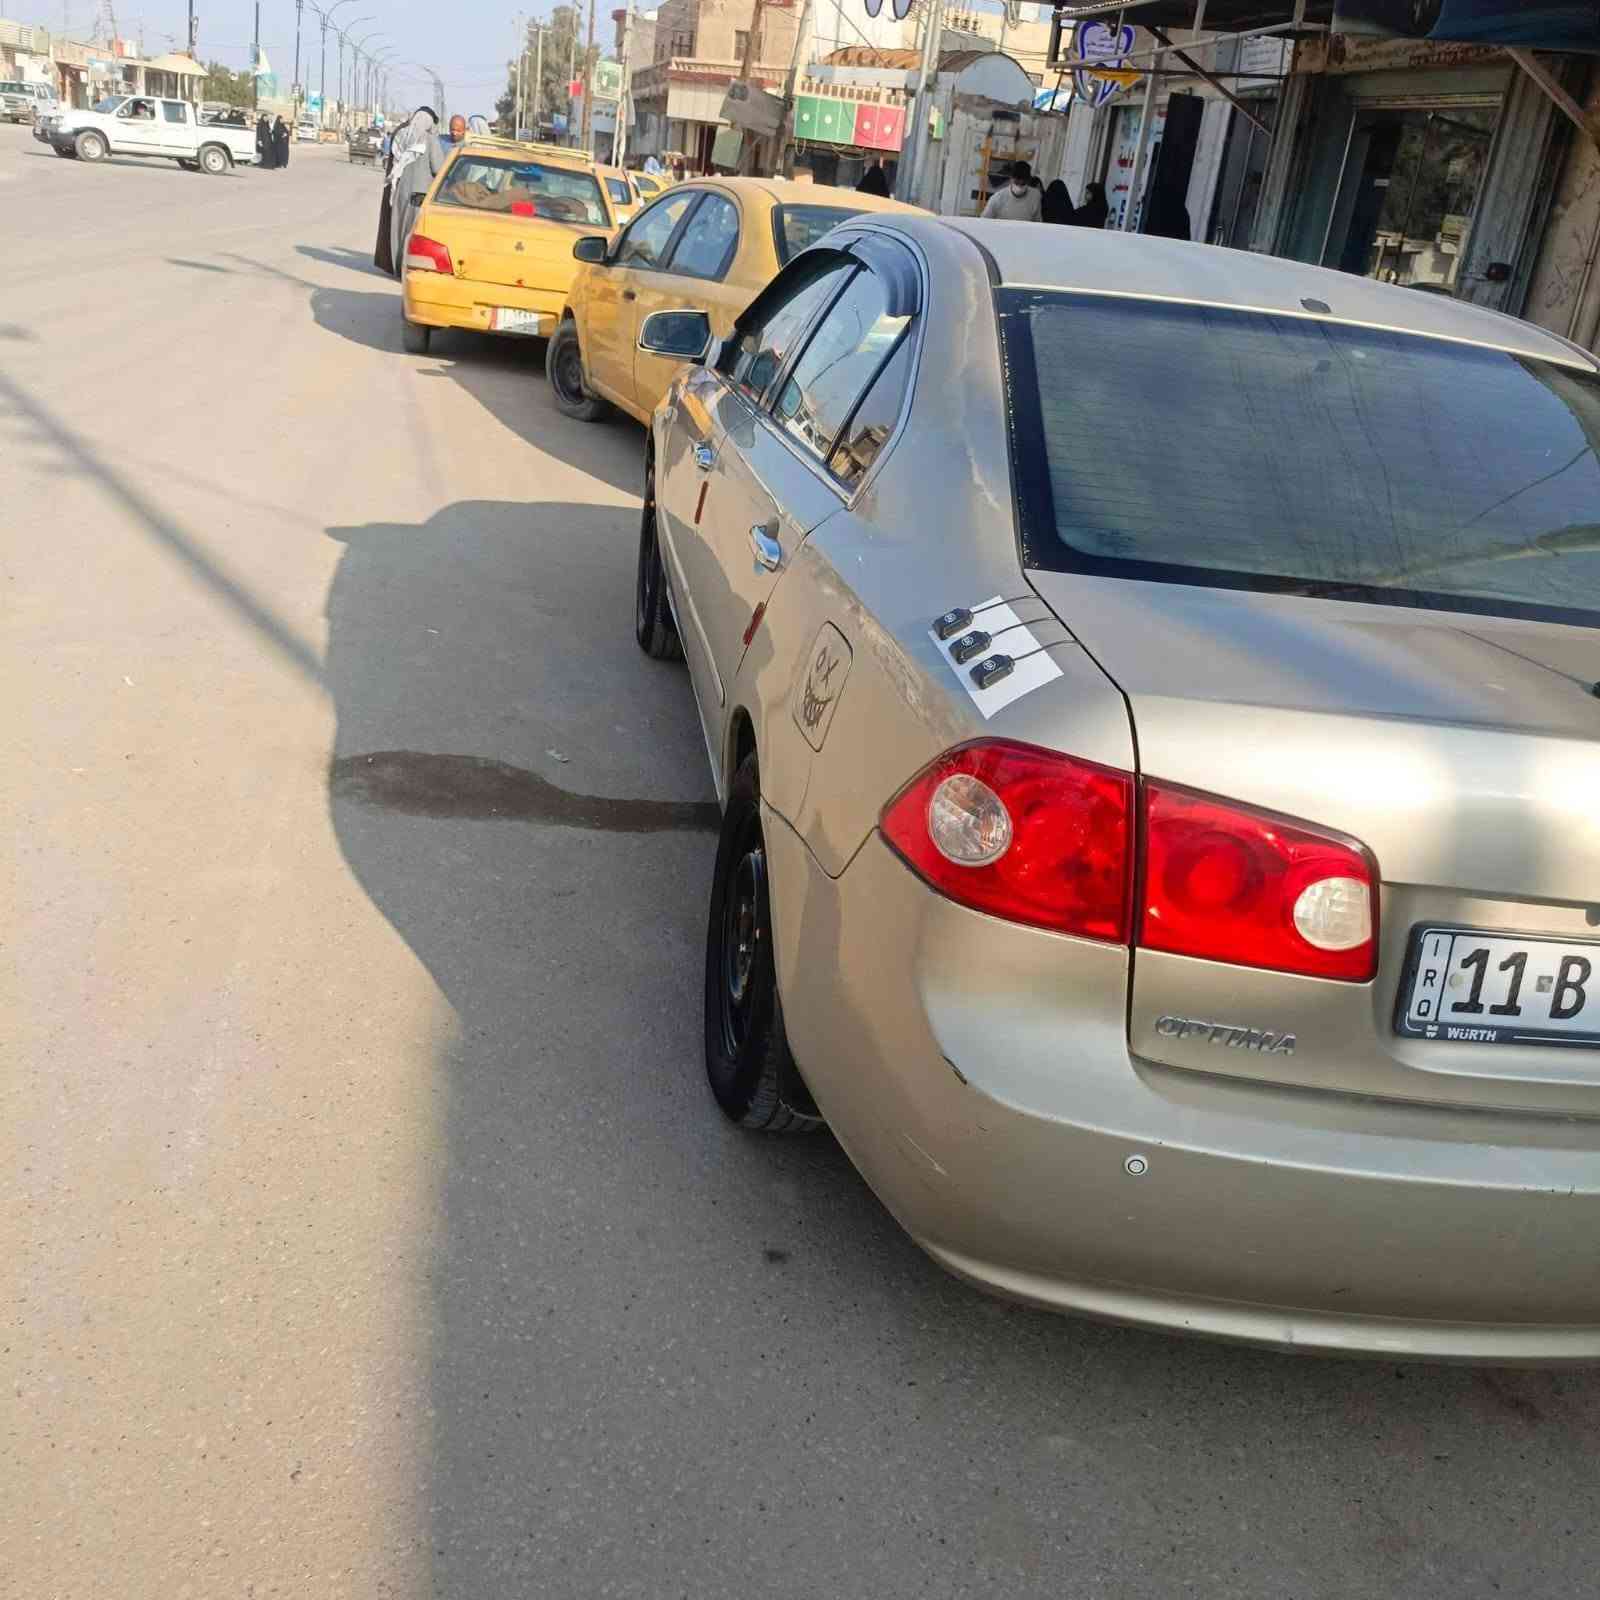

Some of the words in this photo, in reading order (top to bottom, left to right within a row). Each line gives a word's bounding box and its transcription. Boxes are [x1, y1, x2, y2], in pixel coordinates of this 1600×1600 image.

[1451, 948, 1529, 1017] 11
[1548, 954, 1592, 1020] B
[1155, 1015, 1297, 1056] OPTIMA
